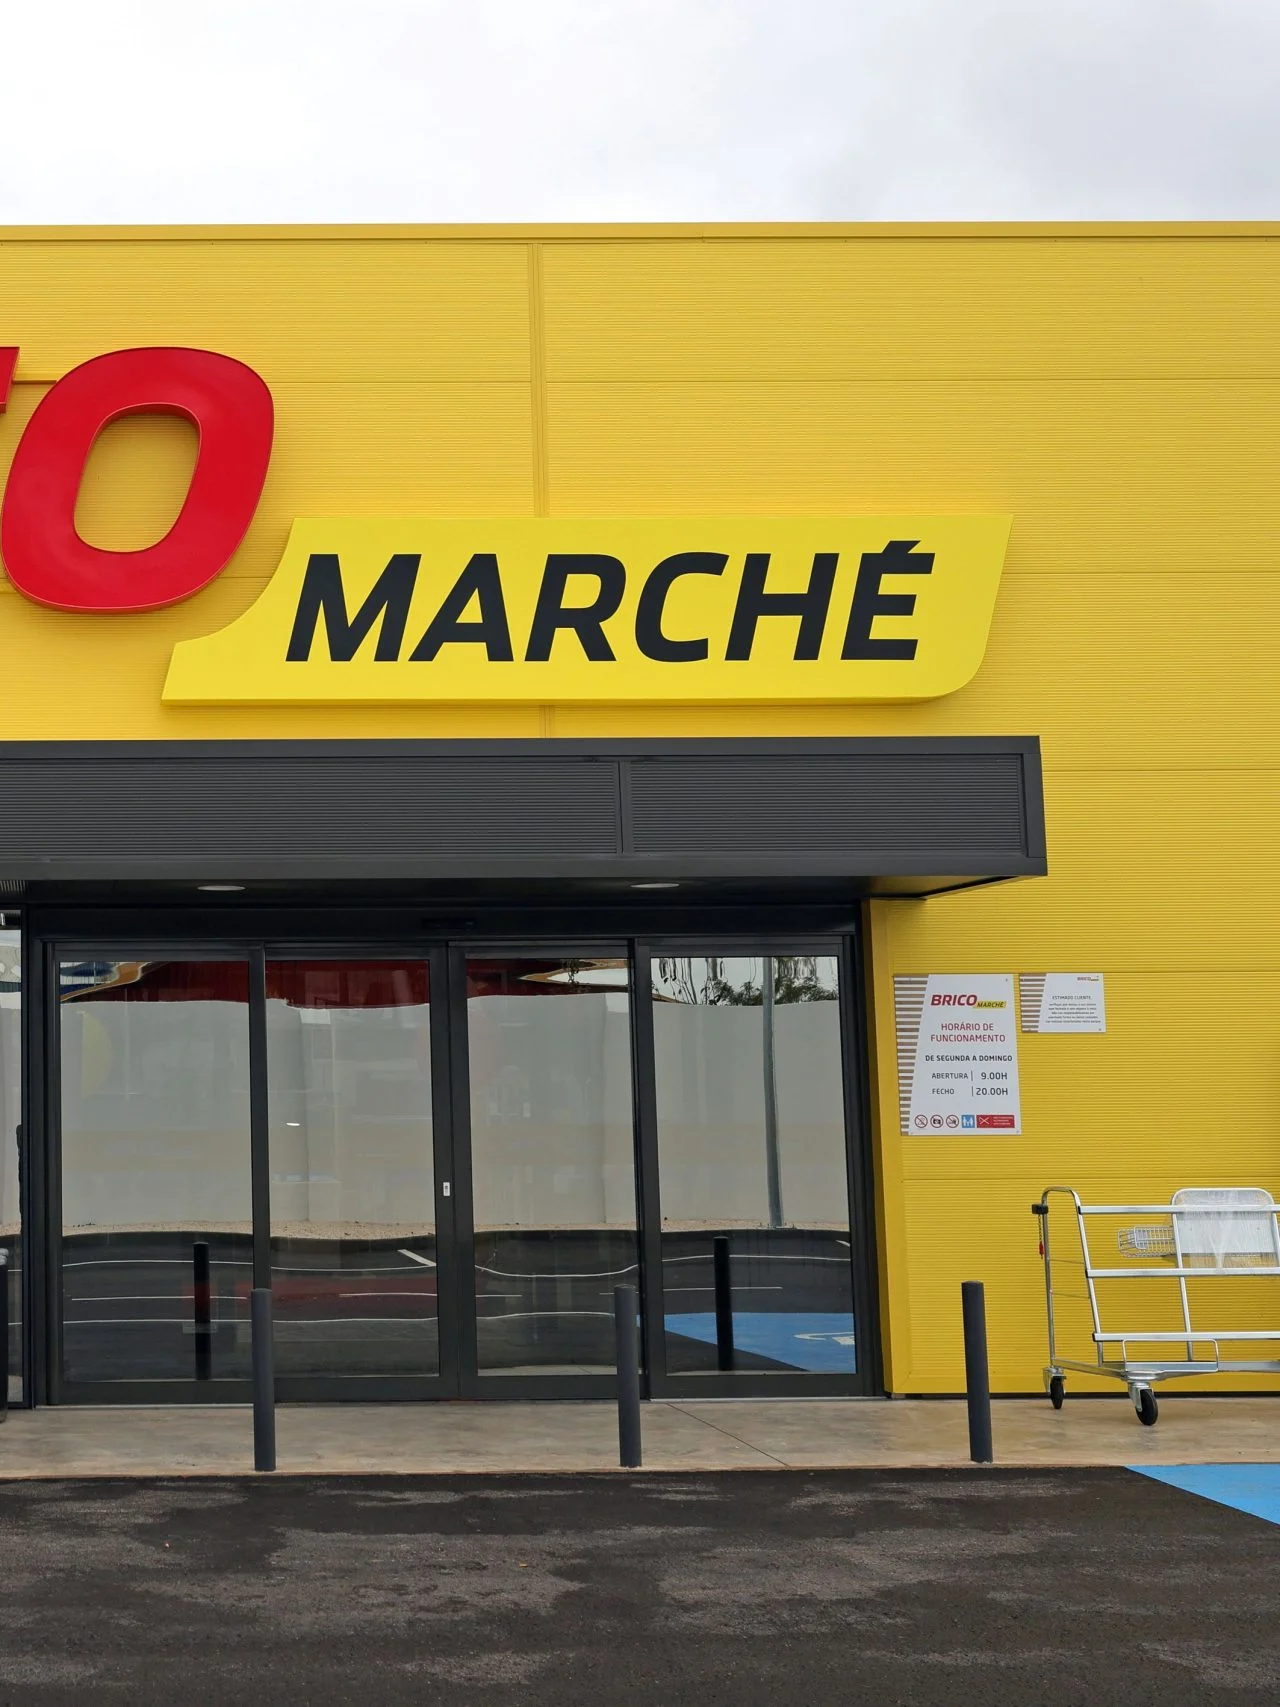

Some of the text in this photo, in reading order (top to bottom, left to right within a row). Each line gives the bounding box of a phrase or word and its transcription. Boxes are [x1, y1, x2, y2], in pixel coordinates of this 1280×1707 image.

[285, 540, 935, 664] MARCHÉ
[930, 994, 978, 1006] BRICO
[941, 1022, 994, 1031] HORÁRIO DE
[930, 1034, 1006, 1042] FUNCIONAMENTO
[980, 1072, 1008, 1080] 9.00H
[975, 1087, 1009, 1096] 20.00H
